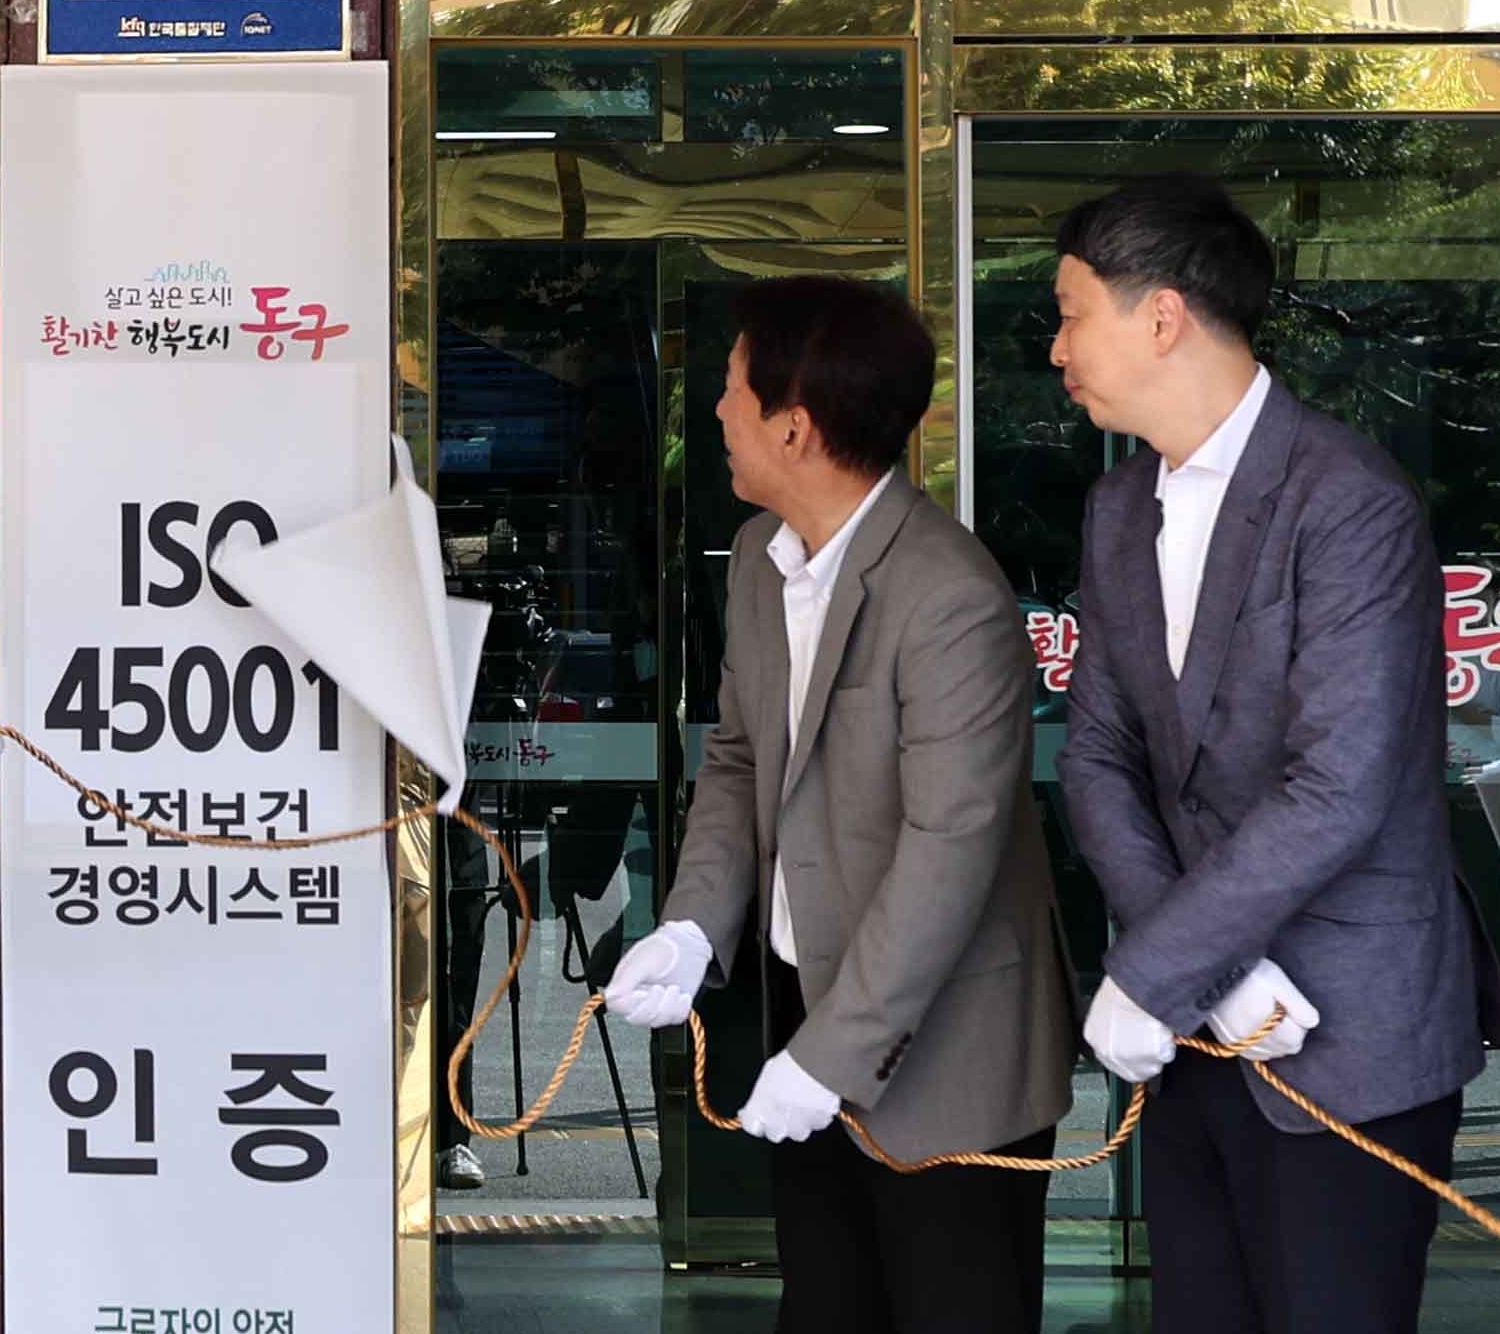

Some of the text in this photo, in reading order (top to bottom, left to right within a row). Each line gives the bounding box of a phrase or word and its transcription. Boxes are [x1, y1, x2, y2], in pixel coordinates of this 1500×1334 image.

[40, 287, 350, 360] 활기찬 행복도시 동구
[105, 286, 232, 310] 살고 싶은 도시!
[44, 645, 340, 753] 45001
[513, 738, 557, 767] 동구
[77, 788, 310, 848] 안전보건
[47, 865, 340, 926] 경영시스템
